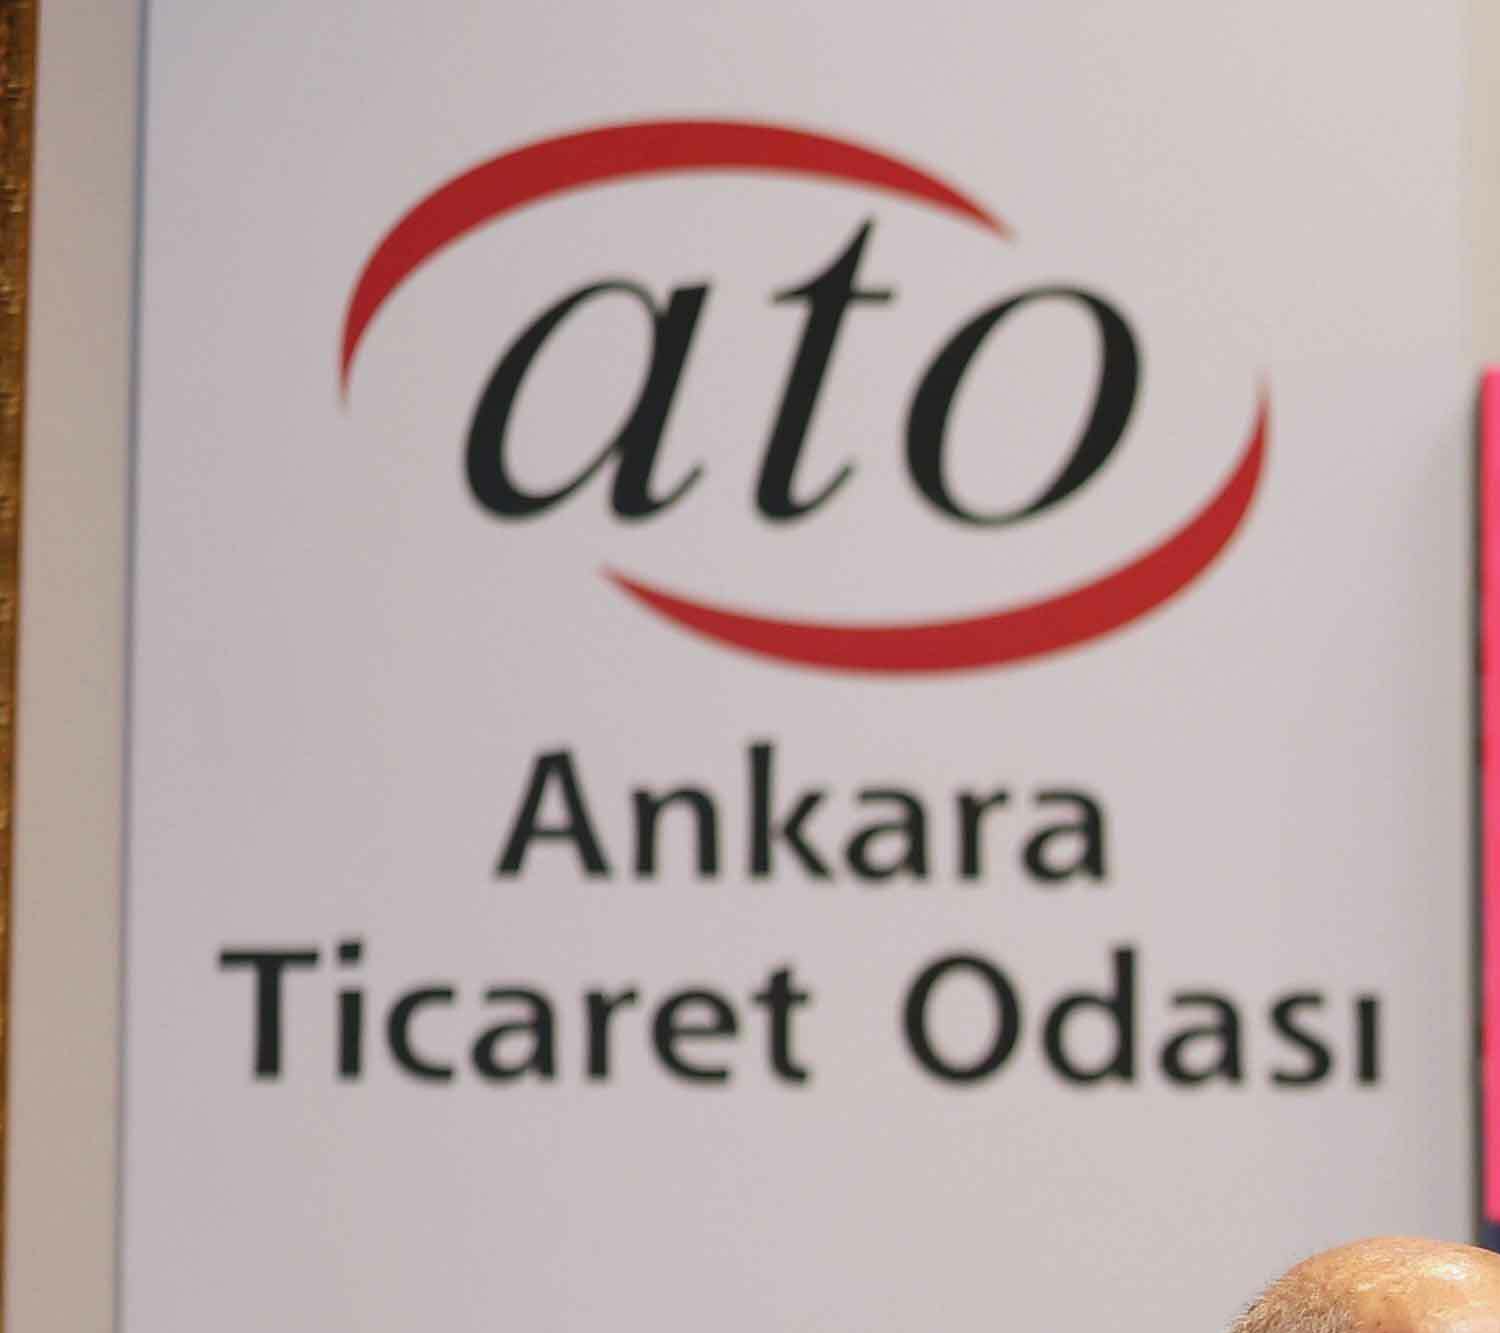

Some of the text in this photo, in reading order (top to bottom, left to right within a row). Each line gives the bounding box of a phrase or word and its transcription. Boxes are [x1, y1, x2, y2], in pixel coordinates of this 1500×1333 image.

[461, 219, 1144, 528] ato
[493, 740, 1109, 886] Ankara
[216, 938, 1382, 1090] Ticaret Odası
